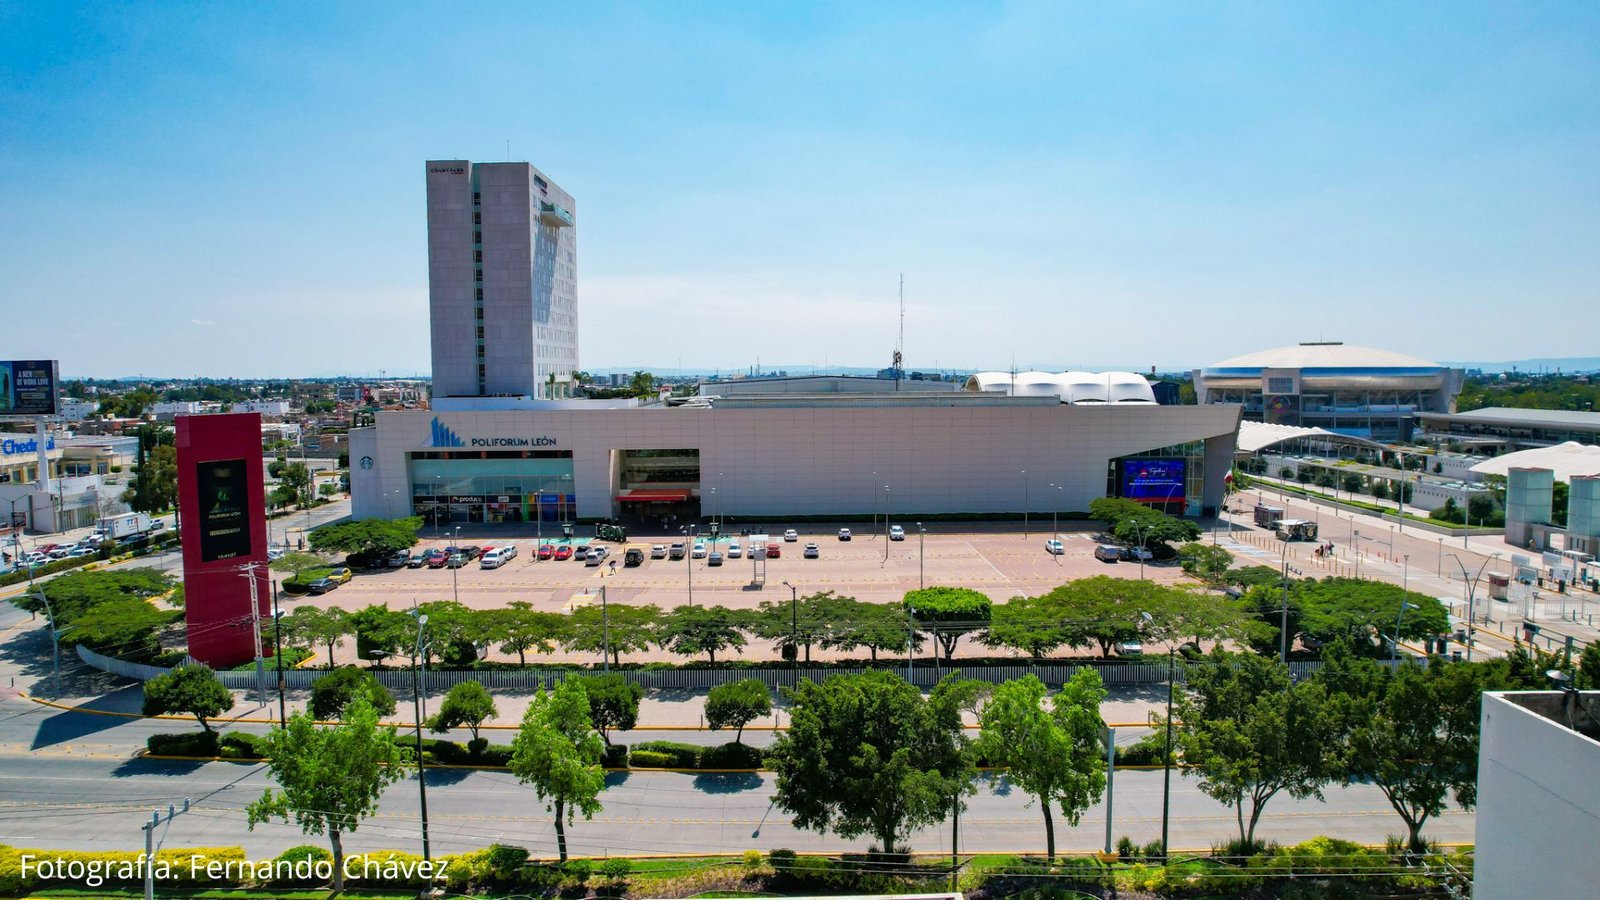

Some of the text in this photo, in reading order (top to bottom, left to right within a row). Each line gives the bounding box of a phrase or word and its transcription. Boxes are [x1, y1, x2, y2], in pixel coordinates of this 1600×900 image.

[37, 377, 49, 385] LOVE
[3, 436, 55, 455] Chedrui
[471, 435, 556, 447] POLIFORUM LEÓN
